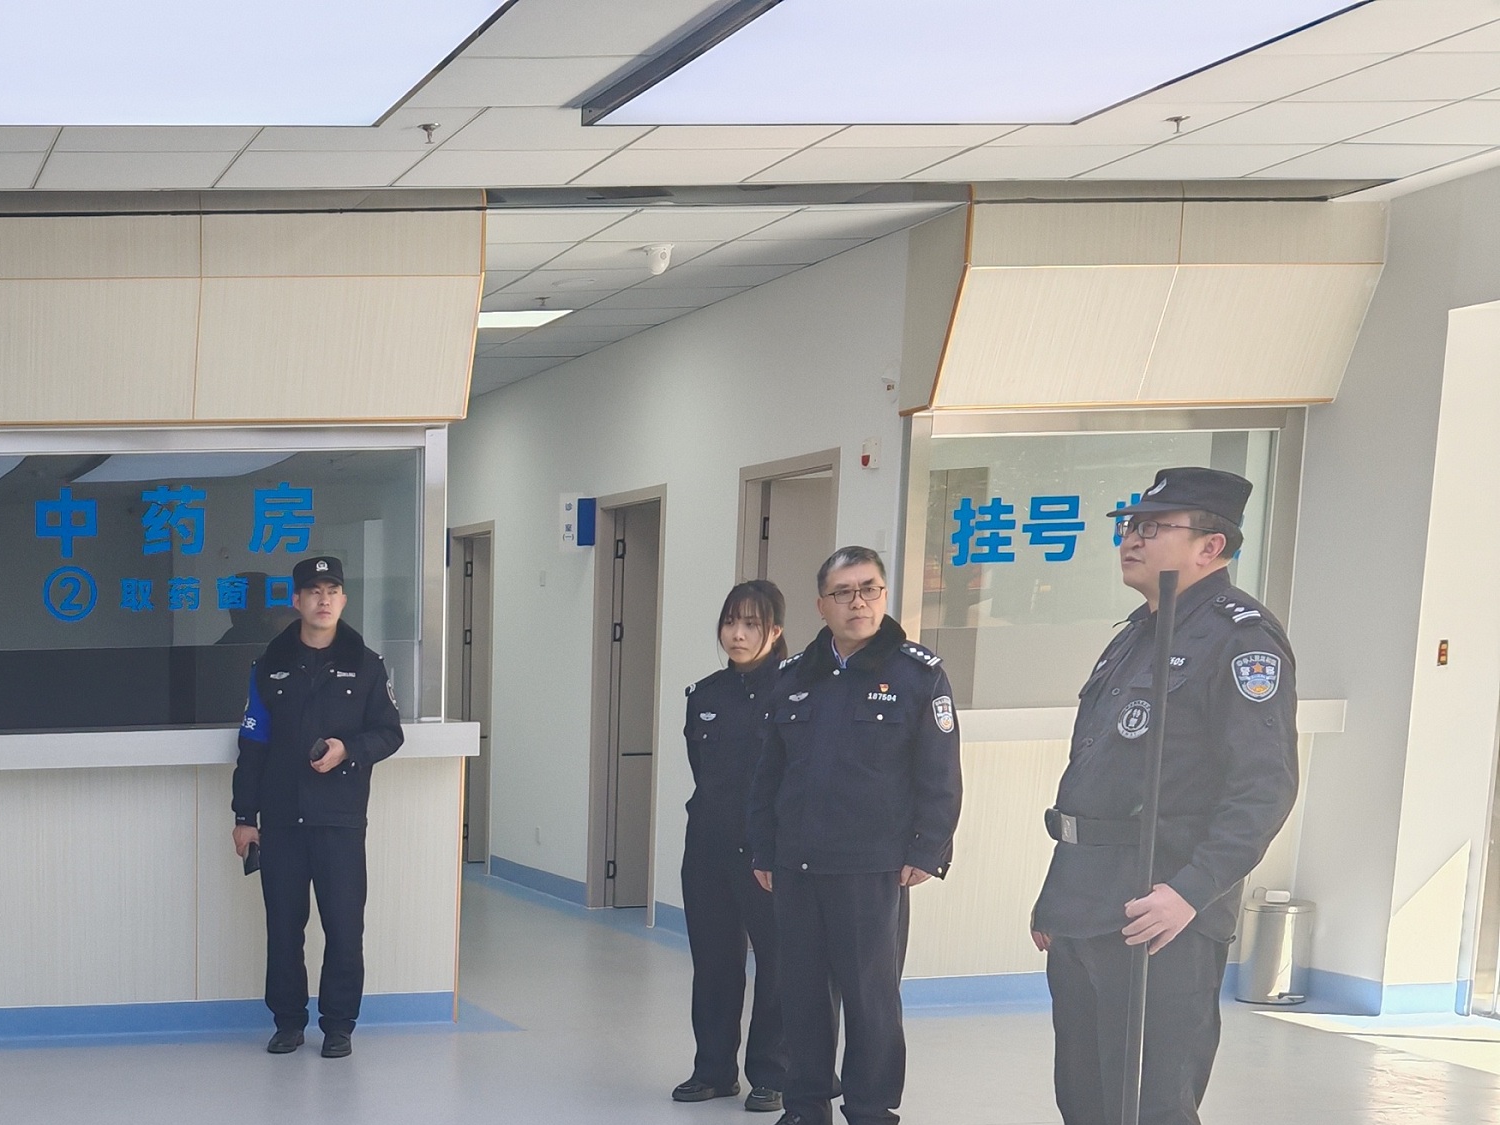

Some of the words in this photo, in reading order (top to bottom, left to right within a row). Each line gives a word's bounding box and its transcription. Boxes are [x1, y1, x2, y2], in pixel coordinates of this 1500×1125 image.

[35, 481, 315, 558] 中药房
[119, 575, 294, 611] 取药窗口
